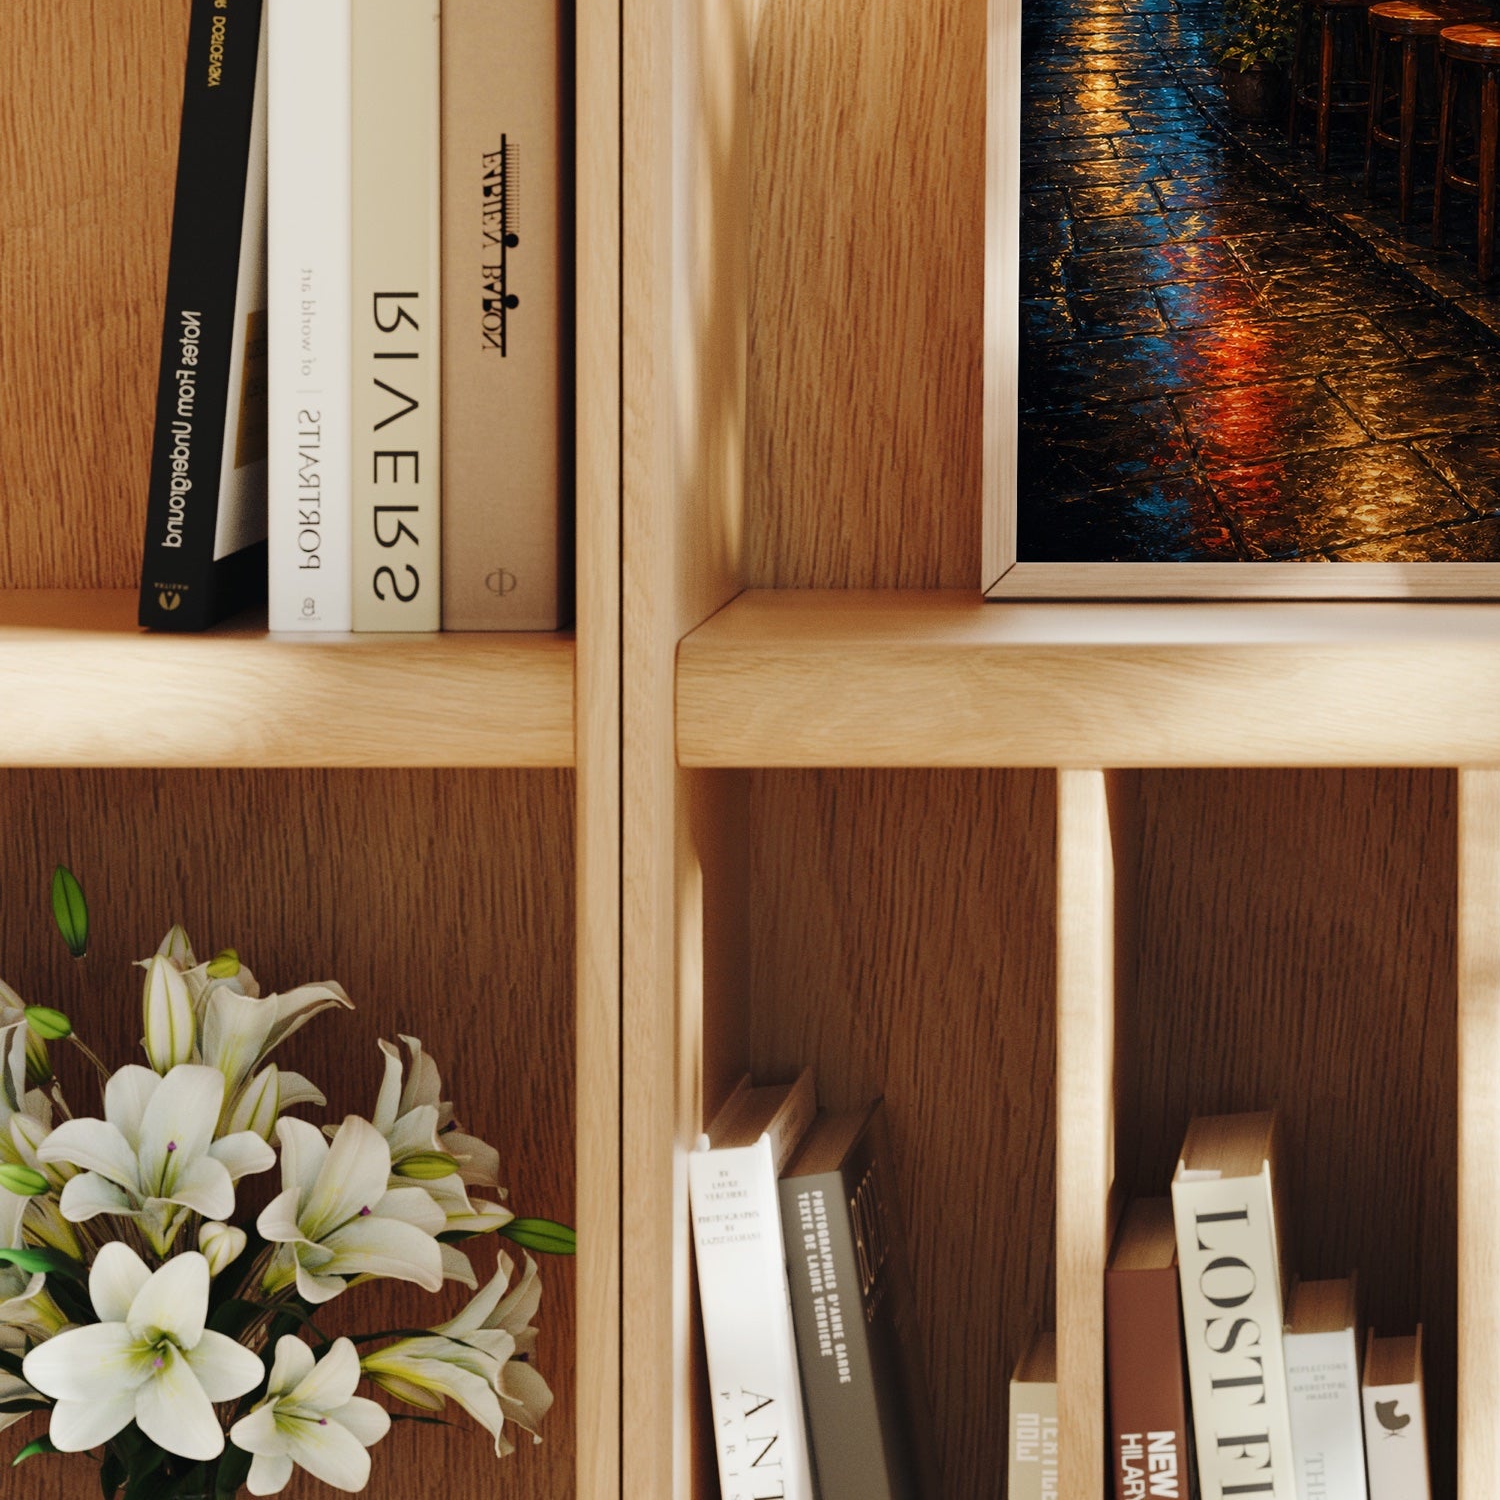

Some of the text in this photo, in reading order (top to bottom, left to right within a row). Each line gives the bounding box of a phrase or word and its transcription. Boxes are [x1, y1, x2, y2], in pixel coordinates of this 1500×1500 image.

[798, 1192, 813, 1231] TEXTE
[804, 1233, 817, 1251] DE
[807, 1255, 823, 1293] LAURE
[811, 1190, 851, 1384] PHOTOGRAPHIES D'ANNE GARDE
[1194, 1203, 1275, 1498] LOST FI
[1146, 1430, 1179, 1498] NEW
